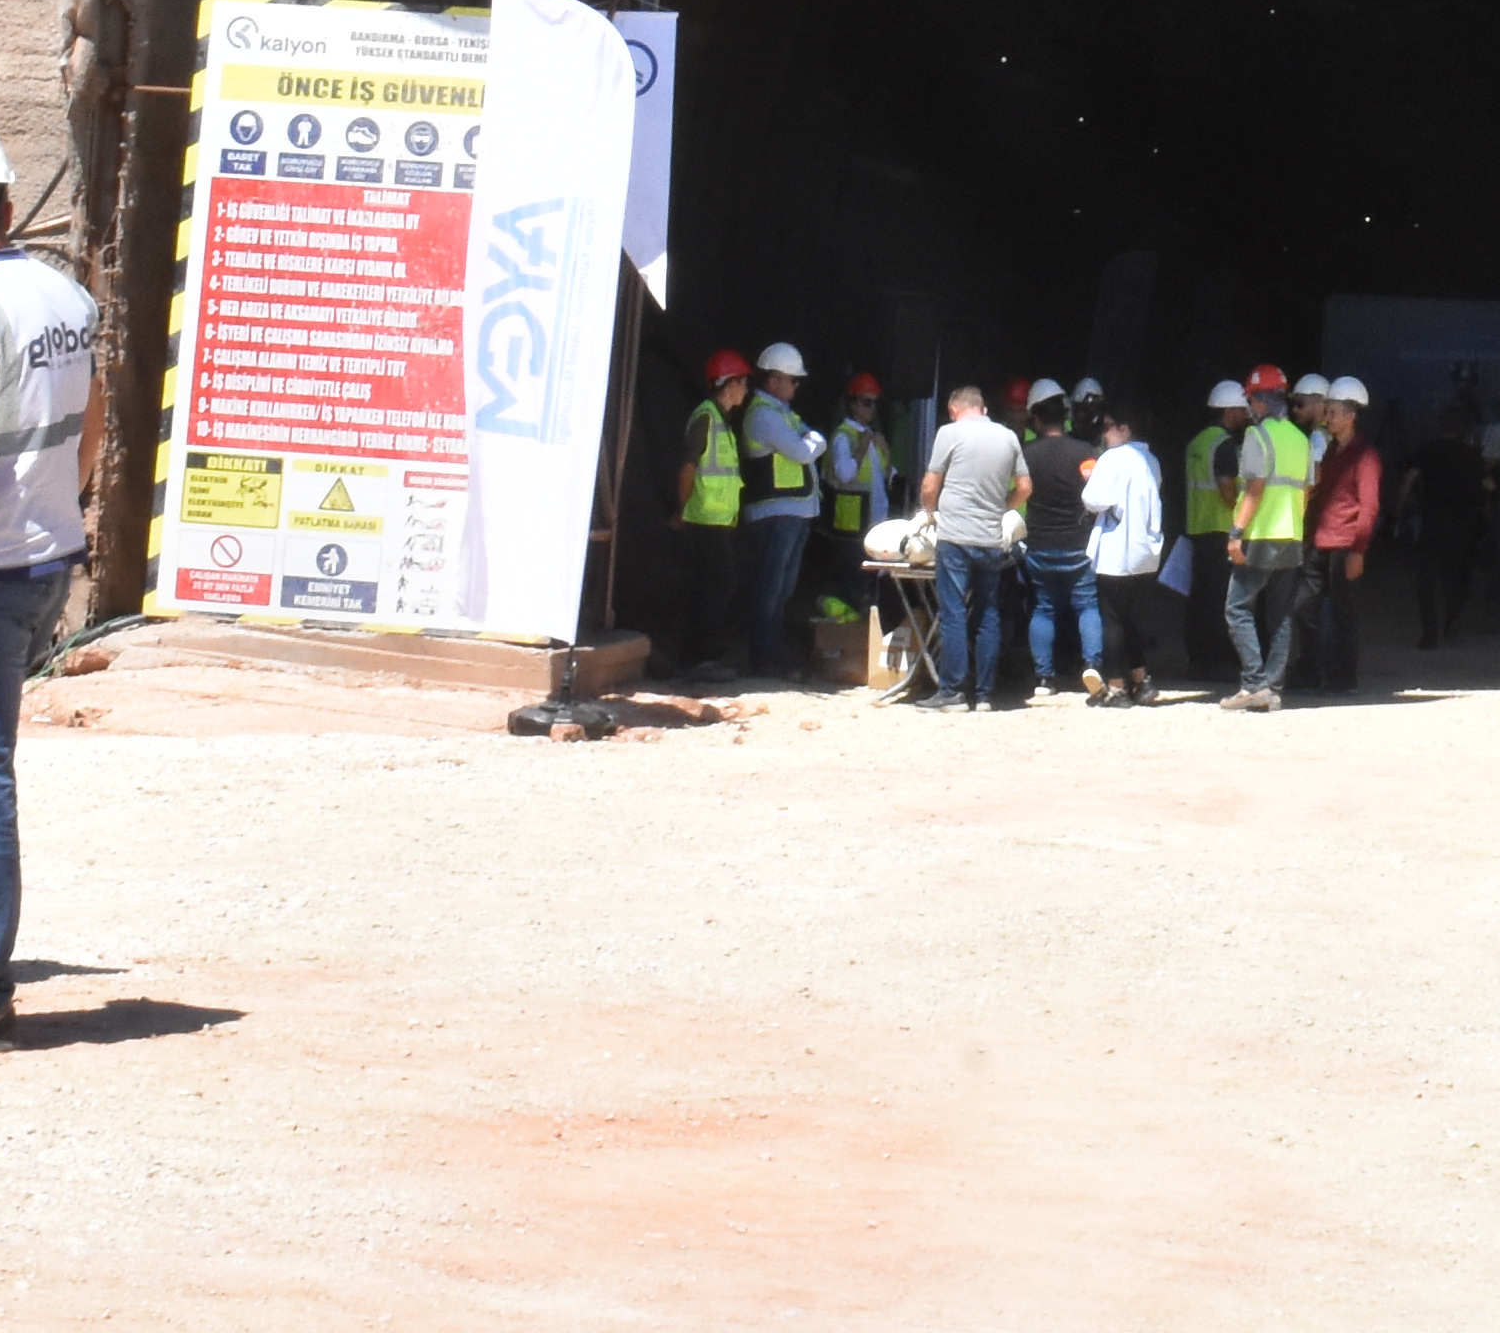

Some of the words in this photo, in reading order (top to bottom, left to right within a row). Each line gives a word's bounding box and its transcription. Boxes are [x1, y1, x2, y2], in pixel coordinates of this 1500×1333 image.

[260, 36, 327, 57] kalyon
[415, 35, 448, 46] BURSA
[277, 72, 342, 99] ÖNCE
[350, 76, 375, 104] İŞ
[315, 463, 364, 475] DİKKAT
